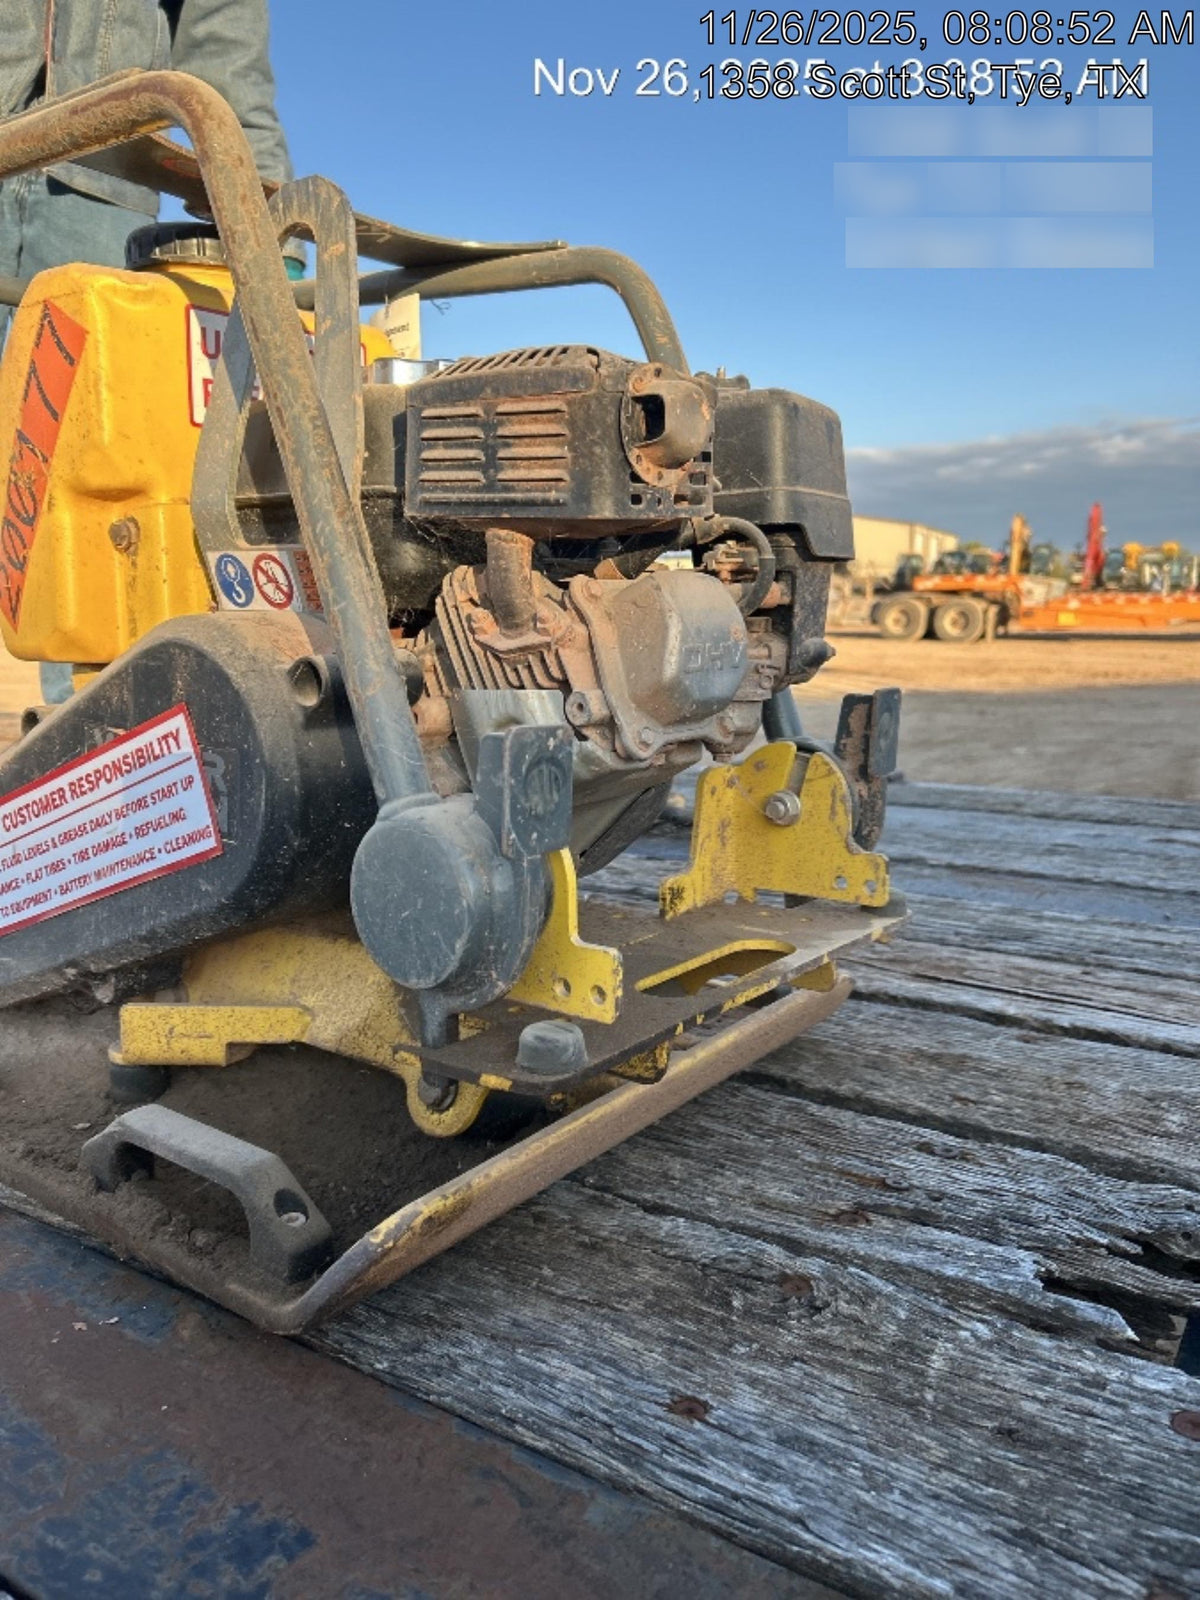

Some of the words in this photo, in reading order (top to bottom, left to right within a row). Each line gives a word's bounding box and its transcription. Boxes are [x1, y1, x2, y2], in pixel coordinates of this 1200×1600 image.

[1, 786, 68, 833] CUSTOMER
[69, 728, 182, 800] RESPONSIBILITY
[23, 840, 50, 861] LEVELS
[58, 822, 89, 845] GREASE
[89, 811, 113, 832] DAILY
[113, 796, 149, 820] BEFORE
[150, 782, 178, 805] START
[181, 775, 194, 791] UP
[10, 888, 52, 914] EQUIPMENT
[58, 872, 93, 896] BATTERY
[94, 847, 156, 880] MAINTENANCE
[163, 825, 212, 854] CLEANING
[26, 867, 43, 884] FLAT
[44, 859, 66, 876] TIRES
[72, 847, 91, 864] TIRE
[91, 832, 128, 857] DAMAGE
[134, 807, 187, 839] REFUELING
